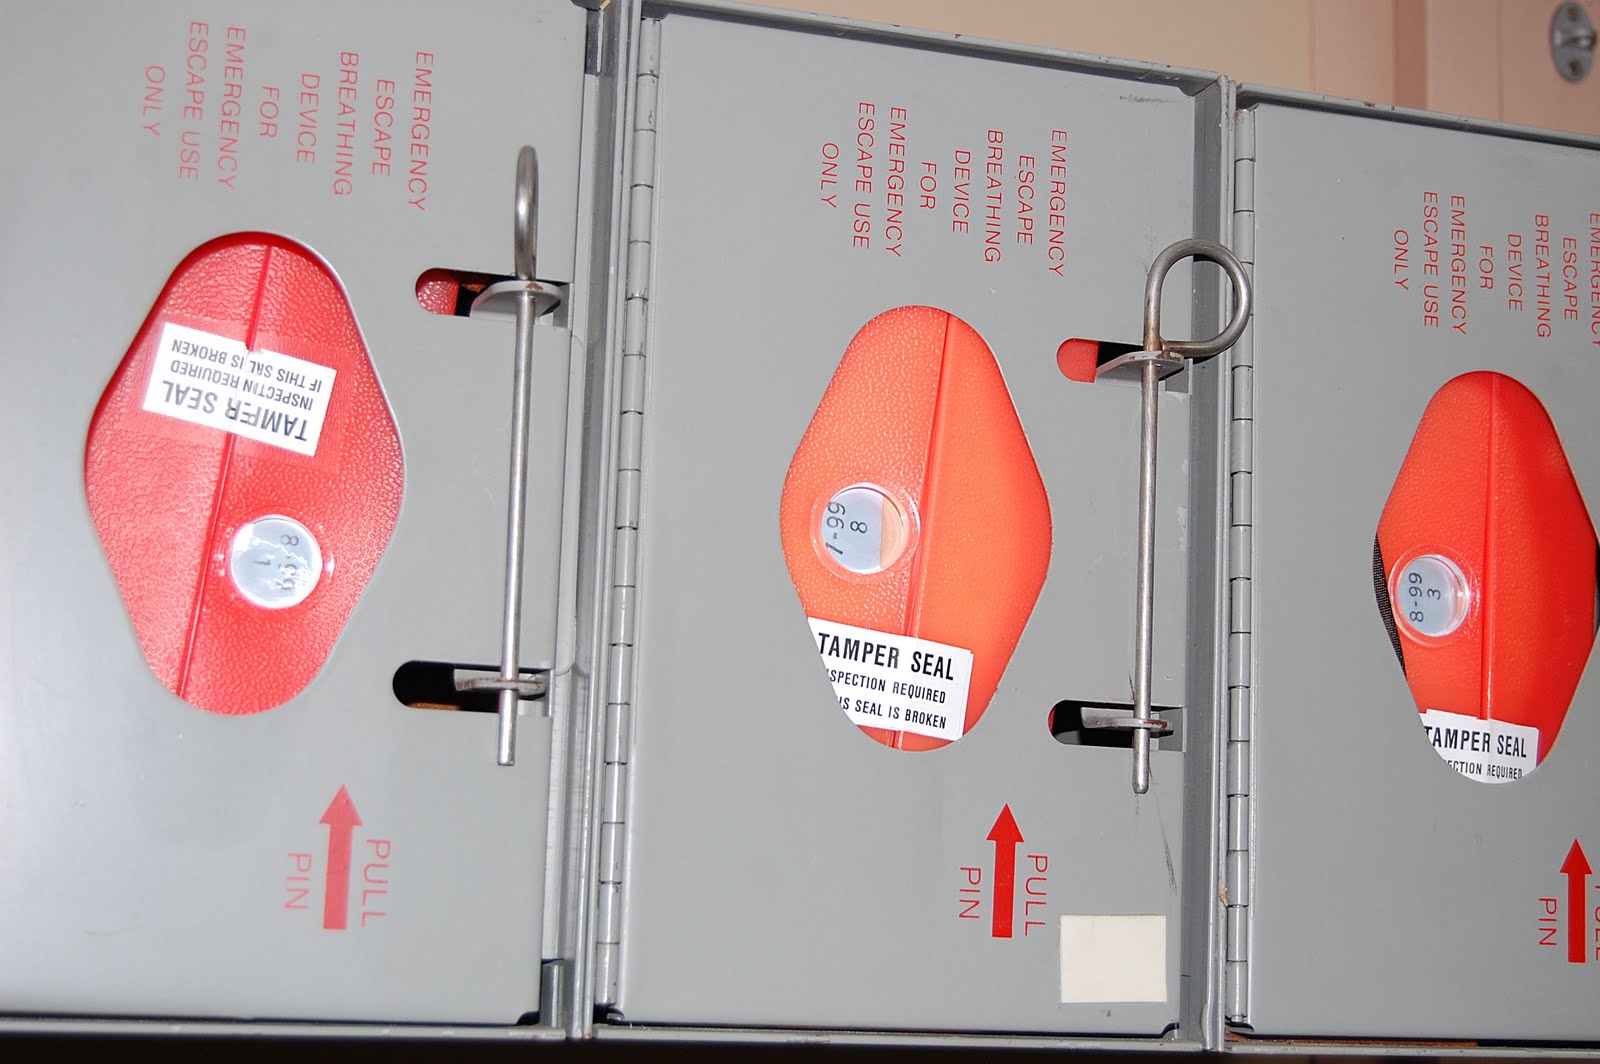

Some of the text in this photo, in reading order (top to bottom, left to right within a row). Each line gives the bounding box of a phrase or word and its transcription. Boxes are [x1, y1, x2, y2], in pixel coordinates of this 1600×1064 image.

[142, 64, 166, 137] ONLY
[177, 21, 209, 181] ESCAPE USE
[216, 26, 247, 191] EMERGENCY
[259, 85, 281, 139] FOR
[295, 73, 320, 165] DEVICE
[333, 51, 359, 197] BREATHING
[371, 79, 396, 177] ESCAPE
[408, 51, 434, 211] EMERGENCY
[820, 142, 840, 208] ONLY
[852, 101, 876, 249] ESCAPE USE
[885, 106, 907, 257] EMERGENCY
[919, 161, 938, 210] FOR
[952, 149, 972, 234] DEVICE
[984, 129, 1005, 263] BREATHING
[1016, 154, 1036, 246] ESCAPE
[1048, 129, 1069, 277] EMERGENCY
[1394, 229, 1410, 290] ONLY
[1423, 191, 1439, 328] ESCAPE USE
[1450, 195, 1467, 335] EMERGENCY
[1479, 245, 1495, 290] FOR
[1507, 233, 1524, 311] DEVICE
[1535, 214, 1552, 338] BREATHING
[1562, 237, 1580, 320] ESCAPE
[170, 360, 240, 388] REQUIRED
[172, 339, 228, 364] BROKEN
[231, 354, 245, 369] IS
[277, 368, 306, 388] THIS
[162, 380, 218, 414] SEAL
[309, 380, 322, 393] IF
[826, 501, 846, 555] 1-99
[850, 521, 868, 534] 8
[1408, 572, 1424, 623] 8-99
[1427, 588, 1441, 600] 3
[818, 632, 954, 681] TAMPER SEAL
[826, 669, 946, 704] SPECTION REQUIRED
[855, 700, 883, 716] SEAL
[888, 705, 900, 719] IS
[905, 709, 947, 729] BROKEN
[1424, 726, 1527, 758] TAMPER SEAL
[1487, 764, 1523, 780] REQUIRED
[283, 853, 313, 910] PIN
[360, 839, 391, 928] PULL
[959, 867, 983, 919] PIN
[1024, 854, 1049, 937] PULL
[1538, 898, 1558, 946] PIN
